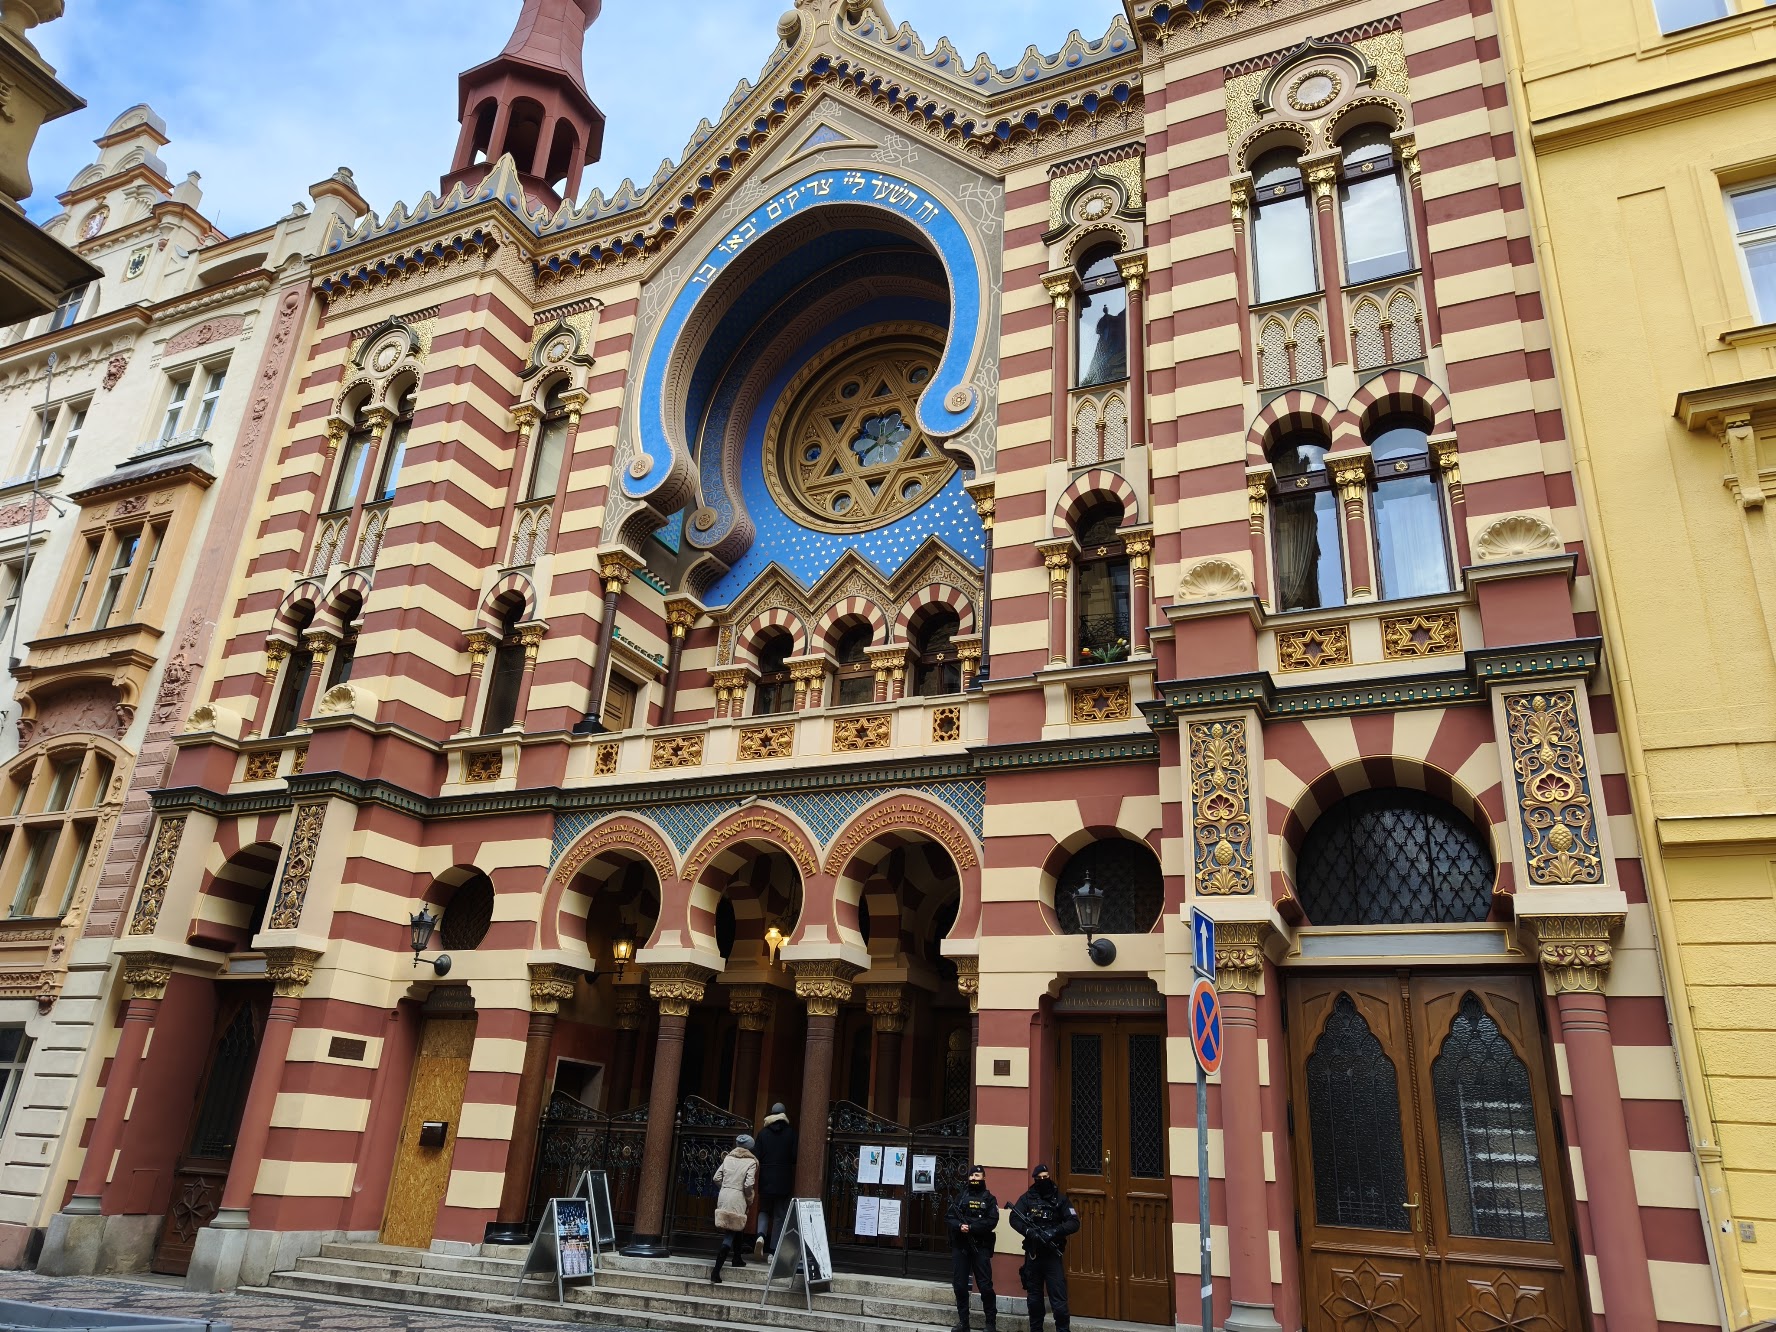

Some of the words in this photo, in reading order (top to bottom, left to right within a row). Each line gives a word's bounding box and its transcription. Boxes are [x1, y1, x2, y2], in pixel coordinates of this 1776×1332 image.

[915, 200, 939, 225] זה
[691, 264, 717, 282] בו
[629, 826, 662, 851] JEDNOHO
[660, 851, 674, 877] OTCE?
[636, 840, 657, 859] JEDEN
[825, 840, 847, 874] HABEN
[847, 822, 866, 839] WIR
[866, 805, 897, 824] NICHT
[899, 804, 925, 815] ALLE
[926, 810, 954, 831] EINEN
[955, 831, 977, 867] VATER?
[829, 857, 843, 877] HAT
[841, 832, 865, 857] NICHT
[865, 822, 881, 836] EIN
[881, 815, 906, 827] GOTT
[906, 815, 924, 826] UNS
[925, 820, 969, 870] GESCHAFFEN?
